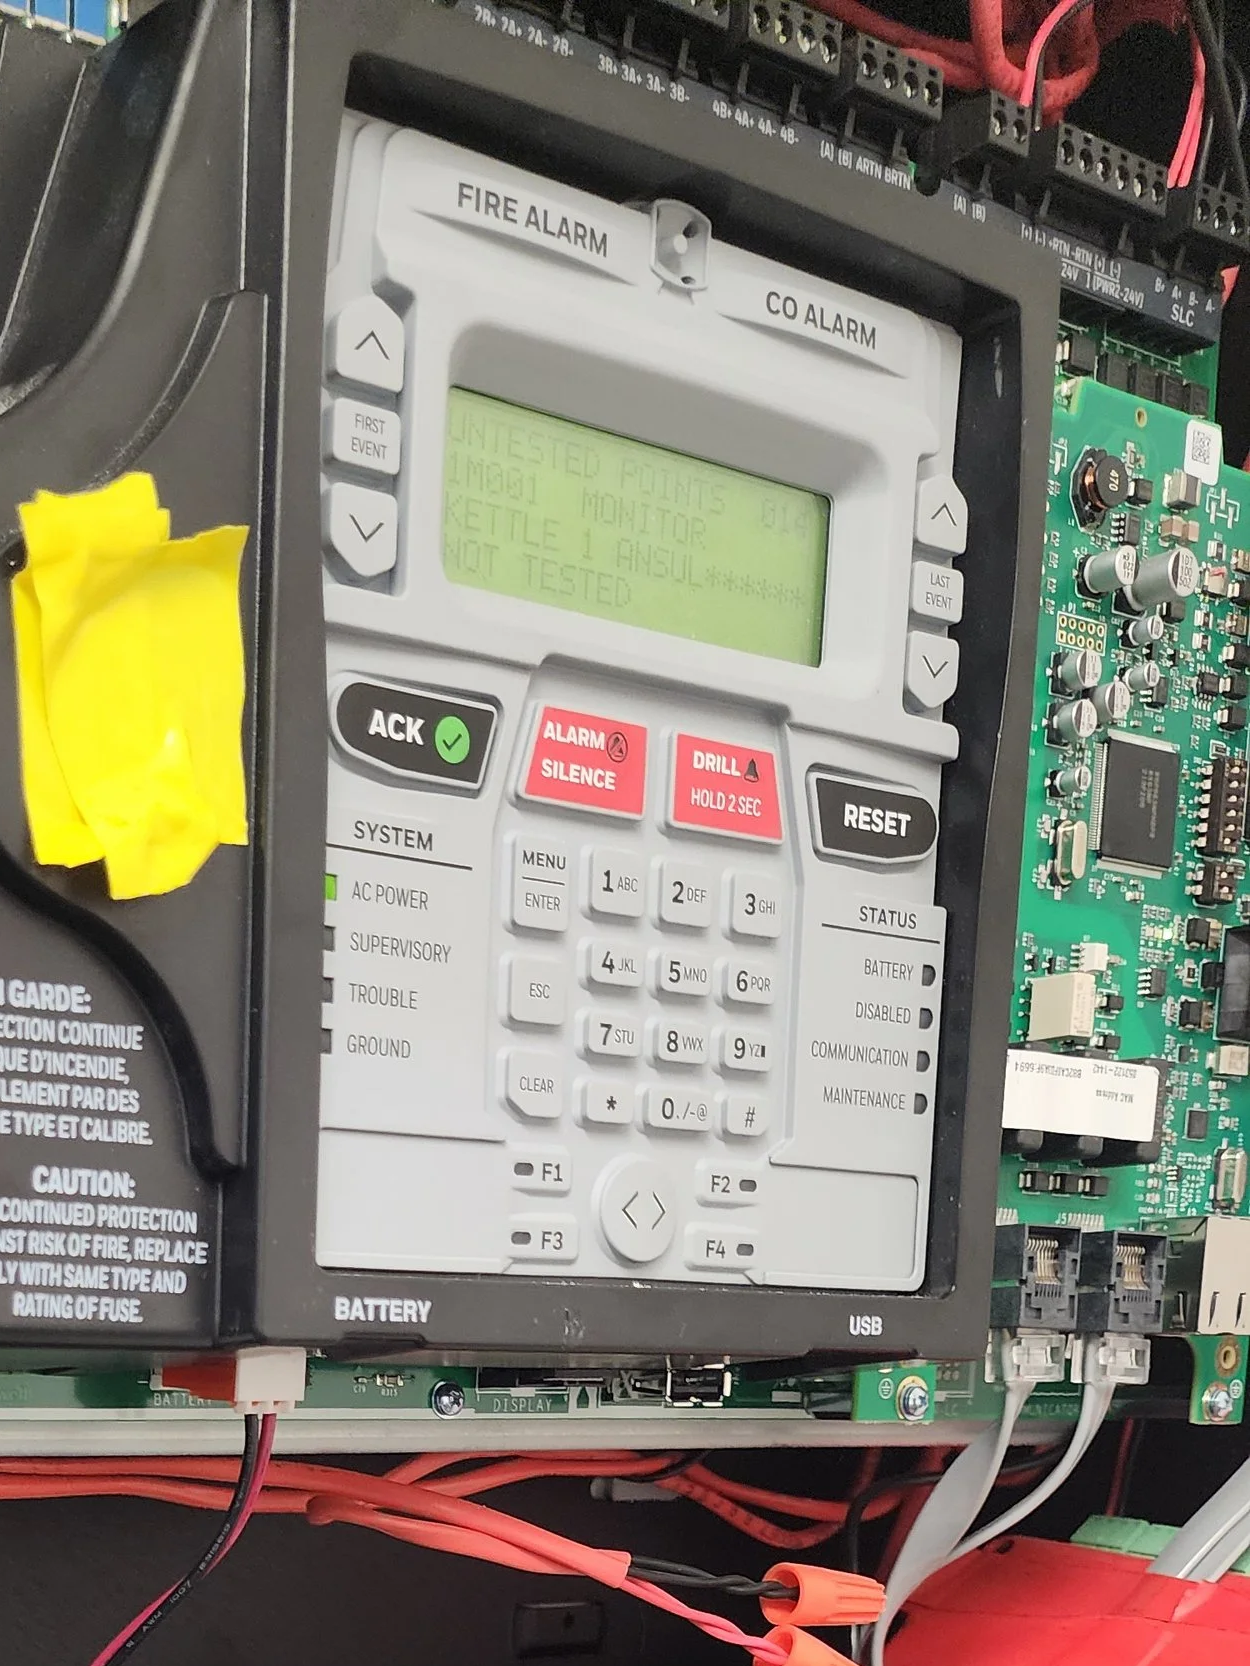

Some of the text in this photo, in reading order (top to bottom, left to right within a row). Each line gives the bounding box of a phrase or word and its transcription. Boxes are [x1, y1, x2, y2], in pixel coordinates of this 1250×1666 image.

[856, 155, 911, 190] ARTN BRTN
[457, 181, 608, 260] FIRE ALARM
[765, 288, 878, 352] CO ALARM
[1171, 304, 1194, 327] SLC
[355, 411, 386, 436] FIRST
[350, 435, 389, 463] EVENT
[449, 411, 726, 515] UNTESTED POINTS
[444, 492, 560, 551] KETTLE
[582, 527, 592, 560] 1
[582, 487, 706, 550] MONITOR
[444, 533, 632, 608] NOT TESTED
[930, 570, 951, 591] LAST
[924, 588, 953, 612] EVENT
[368, 709, 425, 747] ACK
[543, 720, 606, 751] ALARM
[541, 758, 617, 792] SILENCE
[693, 749, 741, 778] DRILL
[690, 786, 763, 818] HOLD 2 SEC
[843, 801, 911, 838] RESET
[354, 819, 434, 852] SYSTEM
[522, 850, 566, 870] MENU
[351, 881, 429, 911] AC POWER
[602, 870, 638, 893] 1 ABC
[672, 881, 707, 904] 2 DEF
[525, 892, 560, 912] ENTER
[744, 894, 776, 916] 3 GHI
[859, 905, 918, 930] STATUS
[349, 930, 452, 965] SUPERVISORY
[602, 951, 637, 974] 4 JKL
[668, 960, 707, 984] 5 MNO
[863, 958, 915, 982] BATTERY
[530, 983, 550, 999] ESC
[736, 970, 770, 992] 6 PQR
[9, 979, 92, 1015] GARDE:
[349, 982, 418, 1011] TROUBLE
[854, 1002, 911, 1025] DISABLED
[58, 1019, 143, 1050] CONTINUE
[347, 1034, 412, 1061] GROUND
[31, 1050, 130, 1085] D'INCENDIE,
[810, 1040, 909, 1069] COMMUNICATION
[73, 1085, 104, 1110] PAR
[107, 1088, 140, 1114] DES
[520, 1076, 554, 1094] CLEAR
[823, 1086, 906, 1111] MAINTENANCE
[14, 1111, 56, 1138] TYPE
[58, 1116, 79, 1140] ET
[81, 1119, 152, 1145] CALIBRE.
[33, 1165, 136, 1199] CAUTION:
[542, 1163, 564, 1183] F1
[710, 1174, 731, 1193] F2
[97, 1204, 198, 1234] PROTECTION
[29, 1233, 65, 1257] RISK
[67, 1236, 91, 1259] OF
[93, 1237, 131, 1263] FIRE,
[133, 1240, 209, 1264] REPLACE
[541, 1231, 564, 1250] F3
[705, 1239, 726, 1259] F4
[19, 1262, 62, 1288] WITH
[64, 1266, 112, 1291] SAME
[114, 1267, 151, 1292] TYPE
[152, 1270, 187, 1294] AND
[13, 1293, 142, 1323] RATING OF FUSE.
[335, 1296, 432, 1325] BATTERY
[849, 1315, 883, 1338] USB
[493, 1397, 552, 1413] DISPLAY
